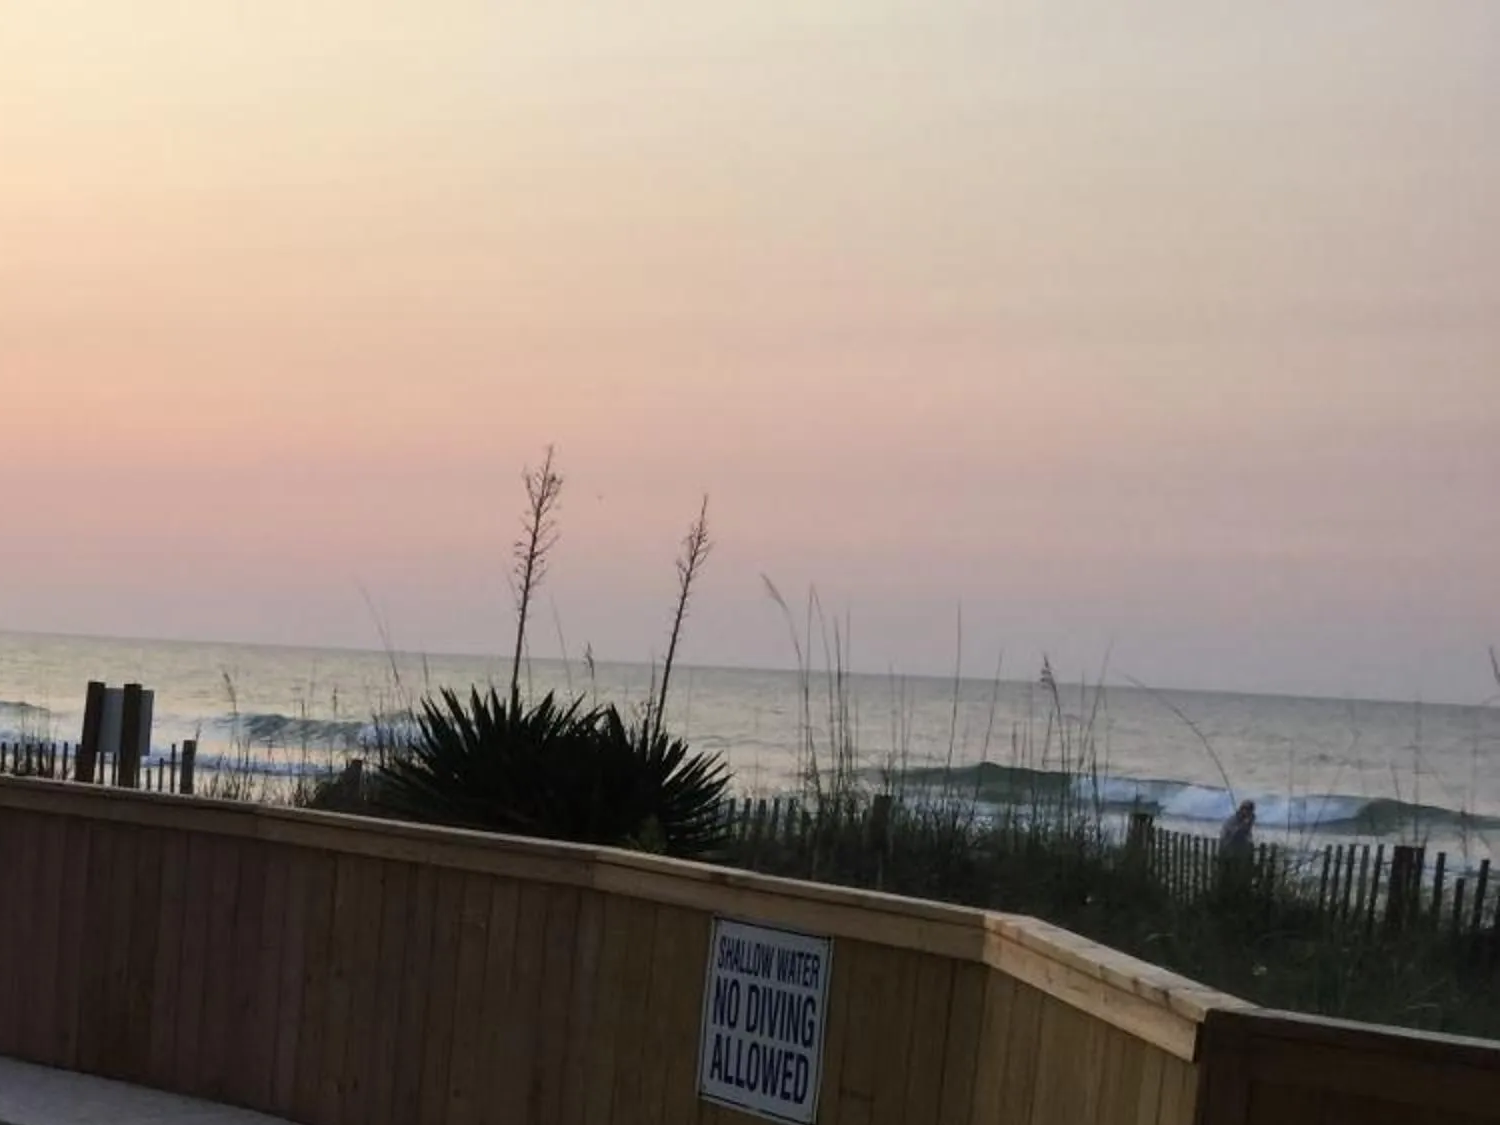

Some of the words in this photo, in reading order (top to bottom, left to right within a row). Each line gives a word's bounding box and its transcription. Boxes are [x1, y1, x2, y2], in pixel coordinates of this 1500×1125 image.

[717, 936, 774, 979] SHALLOW
[776, 950, 820, 990] WATER
[712, 976, 741, 1029] NO
[745, 985, 816, 1048] DIVING
[709, 1033, 809, 1104] ALLOWED
